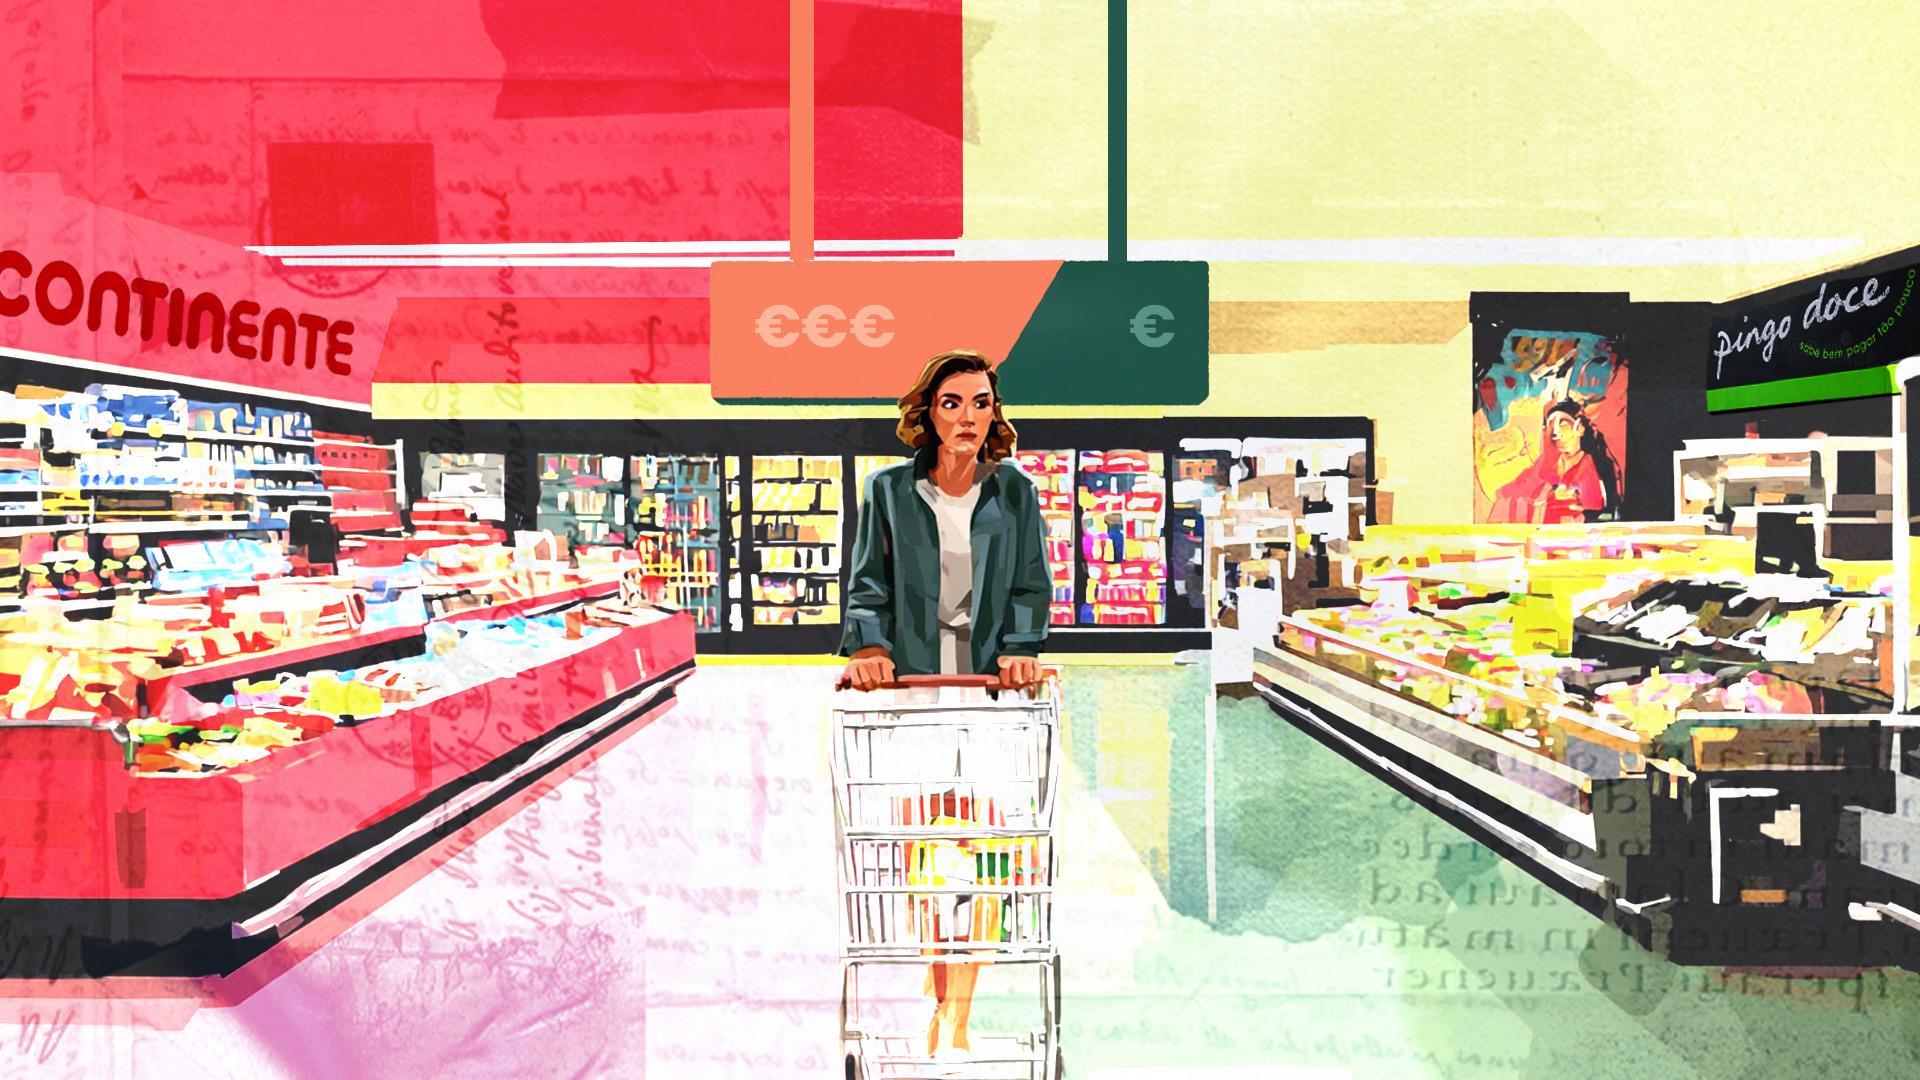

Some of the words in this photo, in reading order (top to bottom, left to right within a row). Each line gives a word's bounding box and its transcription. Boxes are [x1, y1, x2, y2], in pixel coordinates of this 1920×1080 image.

[0, 249, 356, 377] CONTINENTE
[754, 304, 896, 348] €€€
[1130, 304, 1176, 348] €
[1713, 315, 1792, 380] pingo
[1802, 277, 1891, 330] doce
[1799, 341, 1820, 358] sabe
[1822, 349, 1844, 360] bem
[1846, 334, 1877, 359] pagar
[1894, 268, 1917, 319] pouco
